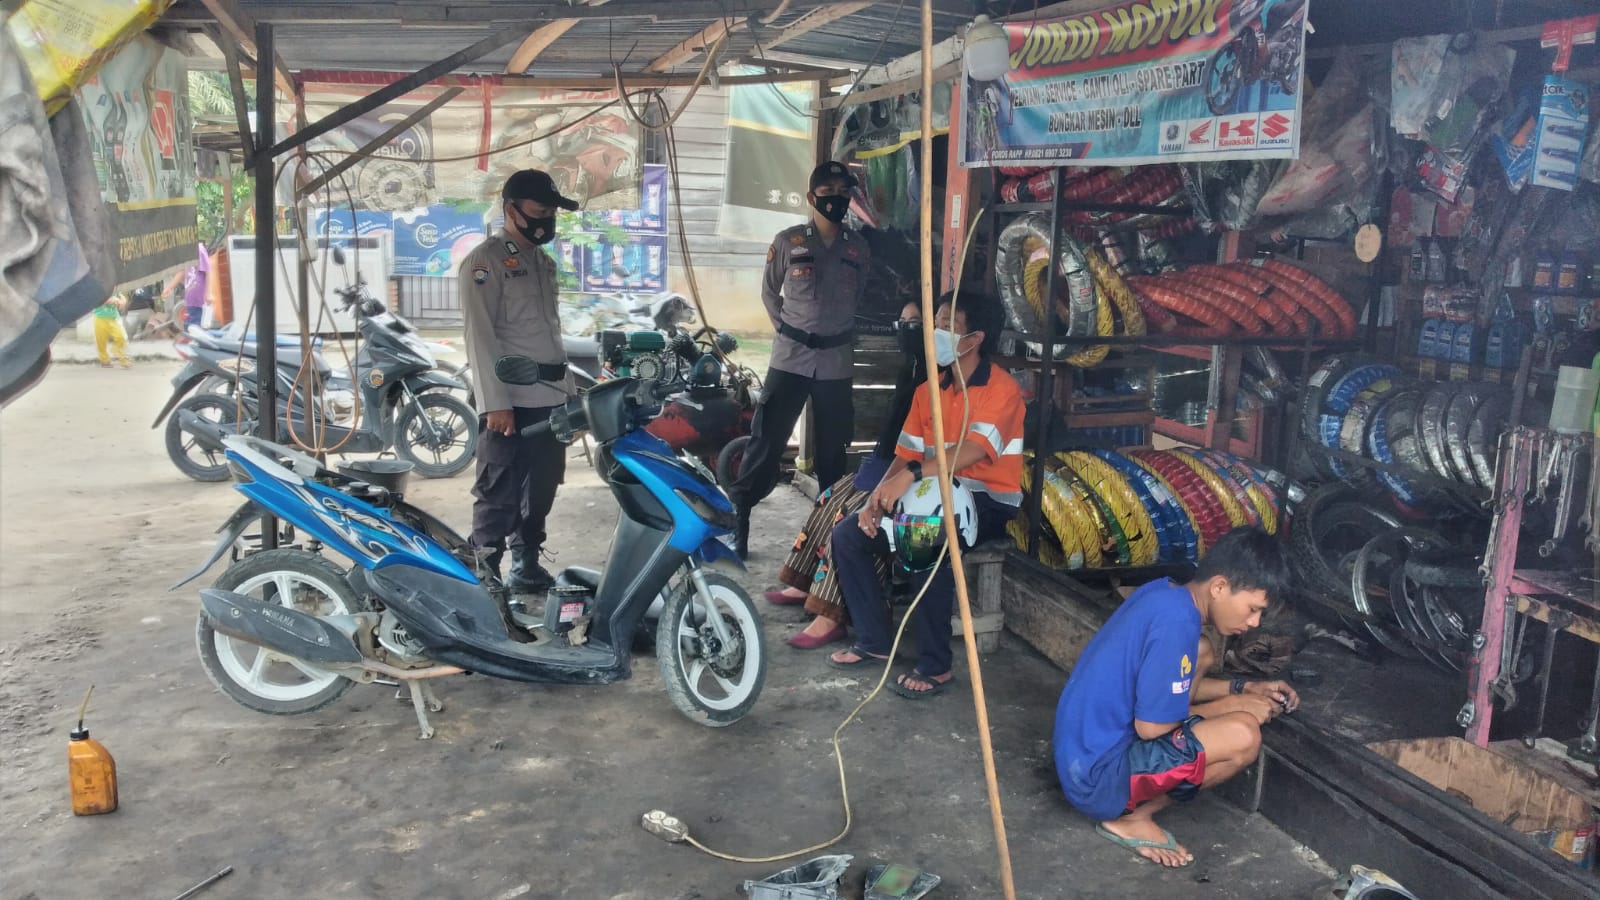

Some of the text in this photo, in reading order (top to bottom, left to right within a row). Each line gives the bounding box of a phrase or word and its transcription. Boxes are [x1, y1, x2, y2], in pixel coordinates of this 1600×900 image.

[1009, 0, 1221, 70] JORDI MOTOR
[1045, 80, 1077, 104] SERVICE
[1083, 75, 1111, 99] GANTI
[1112, 73, 1129, 95] OLI
[1137, 66, 1173, 92] SPARE
[1174, 61, 1206, 88] PART
[1048, 106, 1141, 132] BONGKAR MESIN DLL
[1161, 143, 1182, 152] YAMAHA
[1219, 136, 1255, 146] Kawasaki
